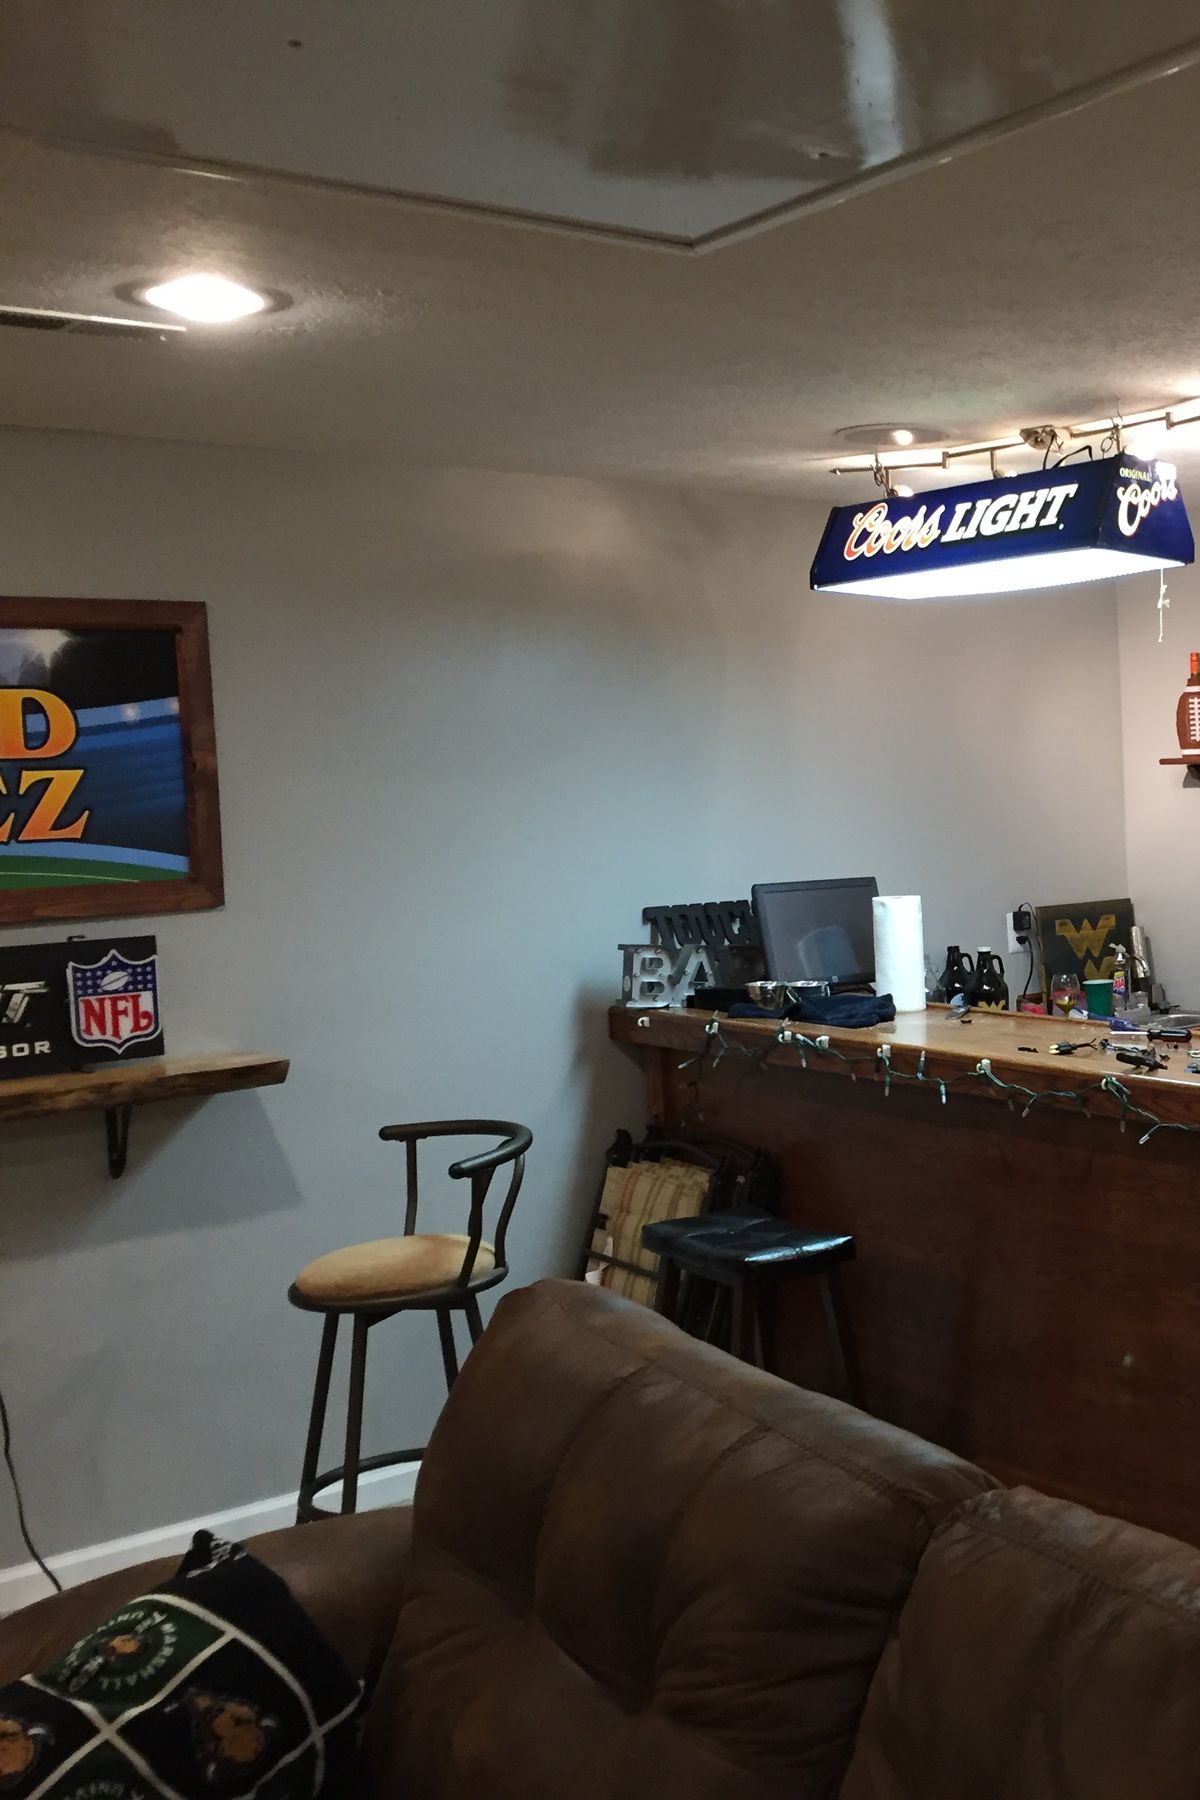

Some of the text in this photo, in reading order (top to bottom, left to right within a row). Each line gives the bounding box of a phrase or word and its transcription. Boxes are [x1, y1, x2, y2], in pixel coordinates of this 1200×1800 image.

[844, 484, 1079, 562] Coors LIGHT
[1116, 482, 1179, 537] Coors
[642, 899, 754, 950] TOUC
[80, 993, 154, 1041] NFL
